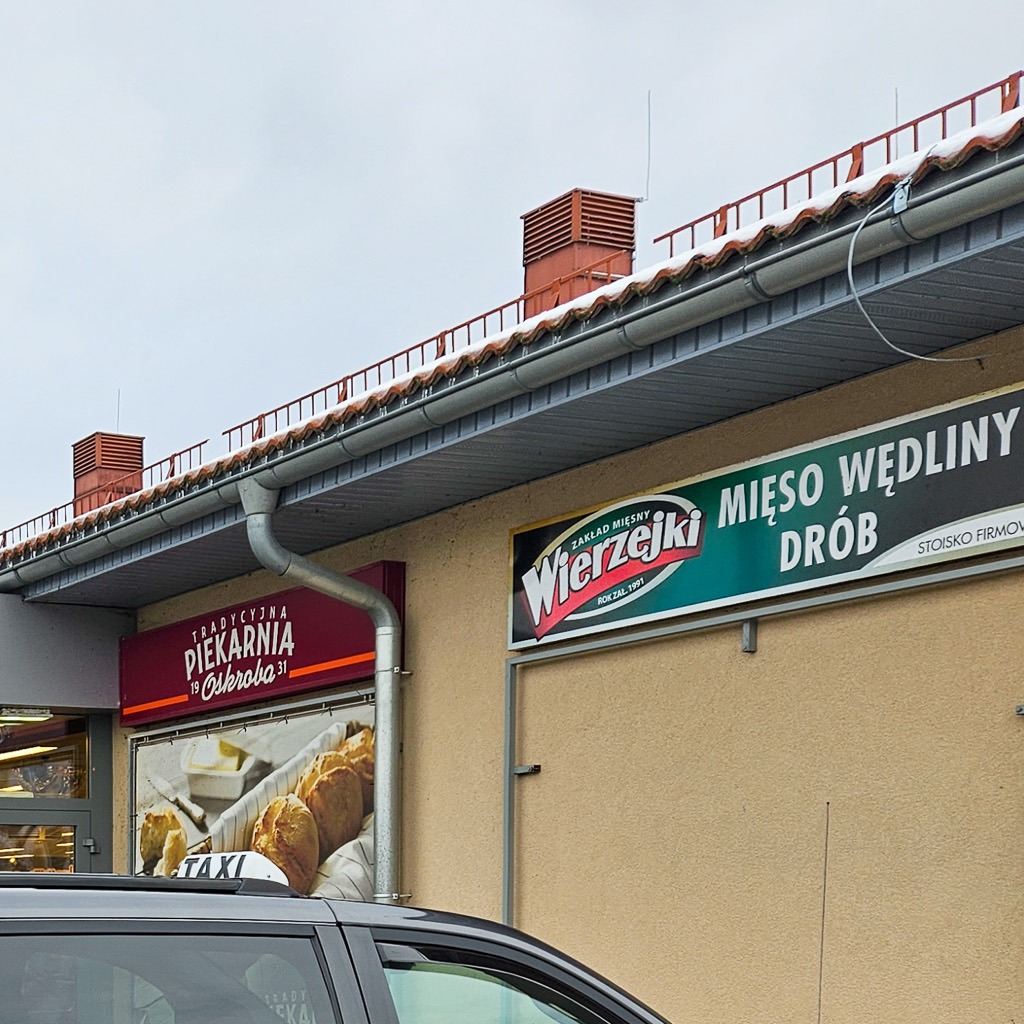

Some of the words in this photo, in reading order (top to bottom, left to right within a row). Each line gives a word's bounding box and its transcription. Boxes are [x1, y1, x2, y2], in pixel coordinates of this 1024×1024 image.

[718, 463, 824, 527] MIĘSO
[839, 407, 1022, 498] WĘDLINY
[571, 524, 610, 551] ZAKŁAD
[612, 509, 651, 531] MIĘSNY
[780, 505, 879, 573] DRÓB
[917, 531, 973, 554] STOISKO
[522, 508, 703, 627] Wierzejki
[597, 593, 613, 605] ROK
[628, 577, 645, 592] 1991
[192, 605, 287, 644] TRADYCYJNA
[184, 621, 295, 681] PIEKARNIA
[190, 680, 200, 695] 19
[201, 658, 276, 701] Oskroba
[277, 659, 287, 675] 31
[184, 855, 247, 878] TAXI
